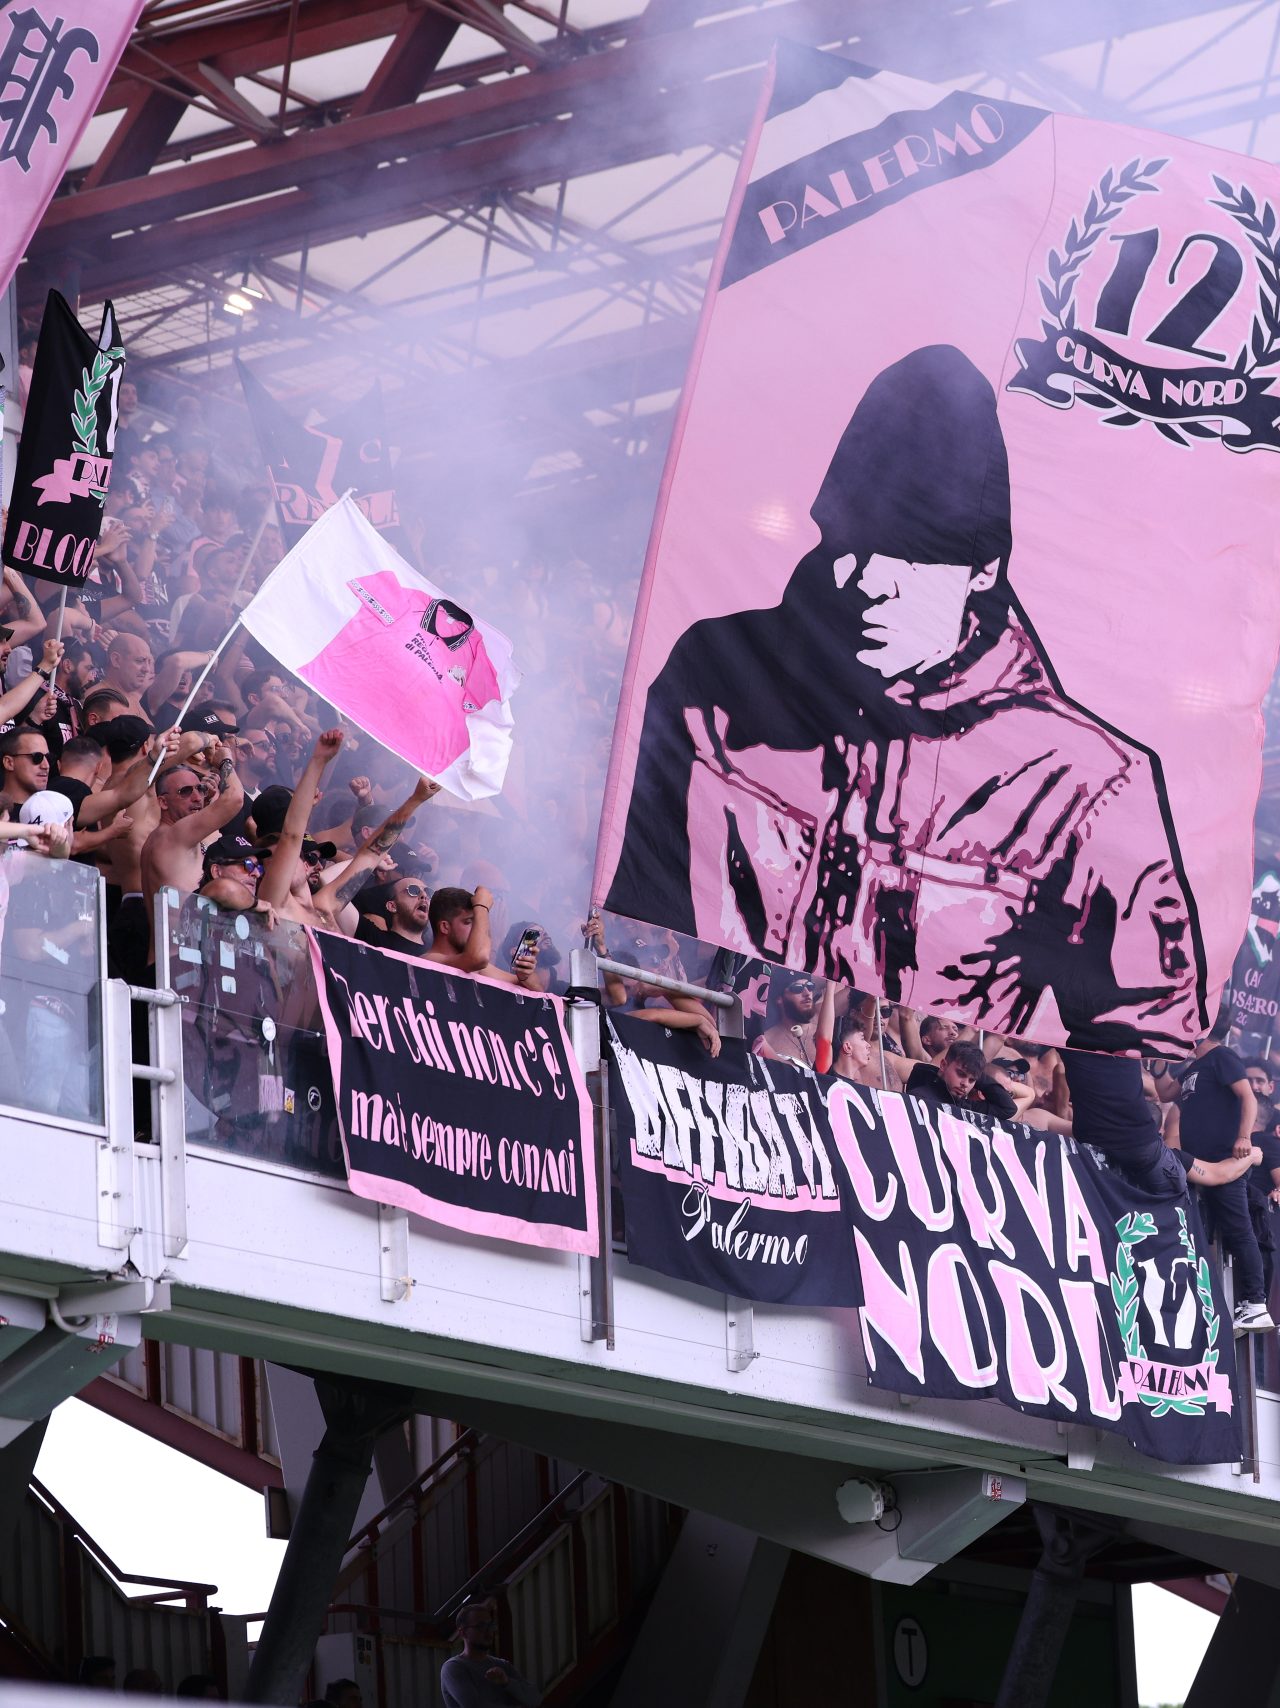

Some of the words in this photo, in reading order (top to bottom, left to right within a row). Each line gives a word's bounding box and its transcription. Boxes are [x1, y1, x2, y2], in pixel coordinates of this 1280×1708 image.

[758, 103, 1004, 245] PALERMO
[1094, 226, 1244, 363] 12
[1056, 335, 1151, 401] CURVA
[1162, 378, 1247, 407] NORD
[393, 997, 456, 1074] chi
[447, 1021, 522, 1091] non
[513, 1026, 566, 1101] c'è
[411, 1112, 493, 1181] sempre
[608, 1039, 839, 1199] DIFFIDATI
[681, 1183, 809, 1266] Palermo
[827, 1080, 1110, 1287] CURVA
[1129, 1361, 1211, 1396] PALERM
